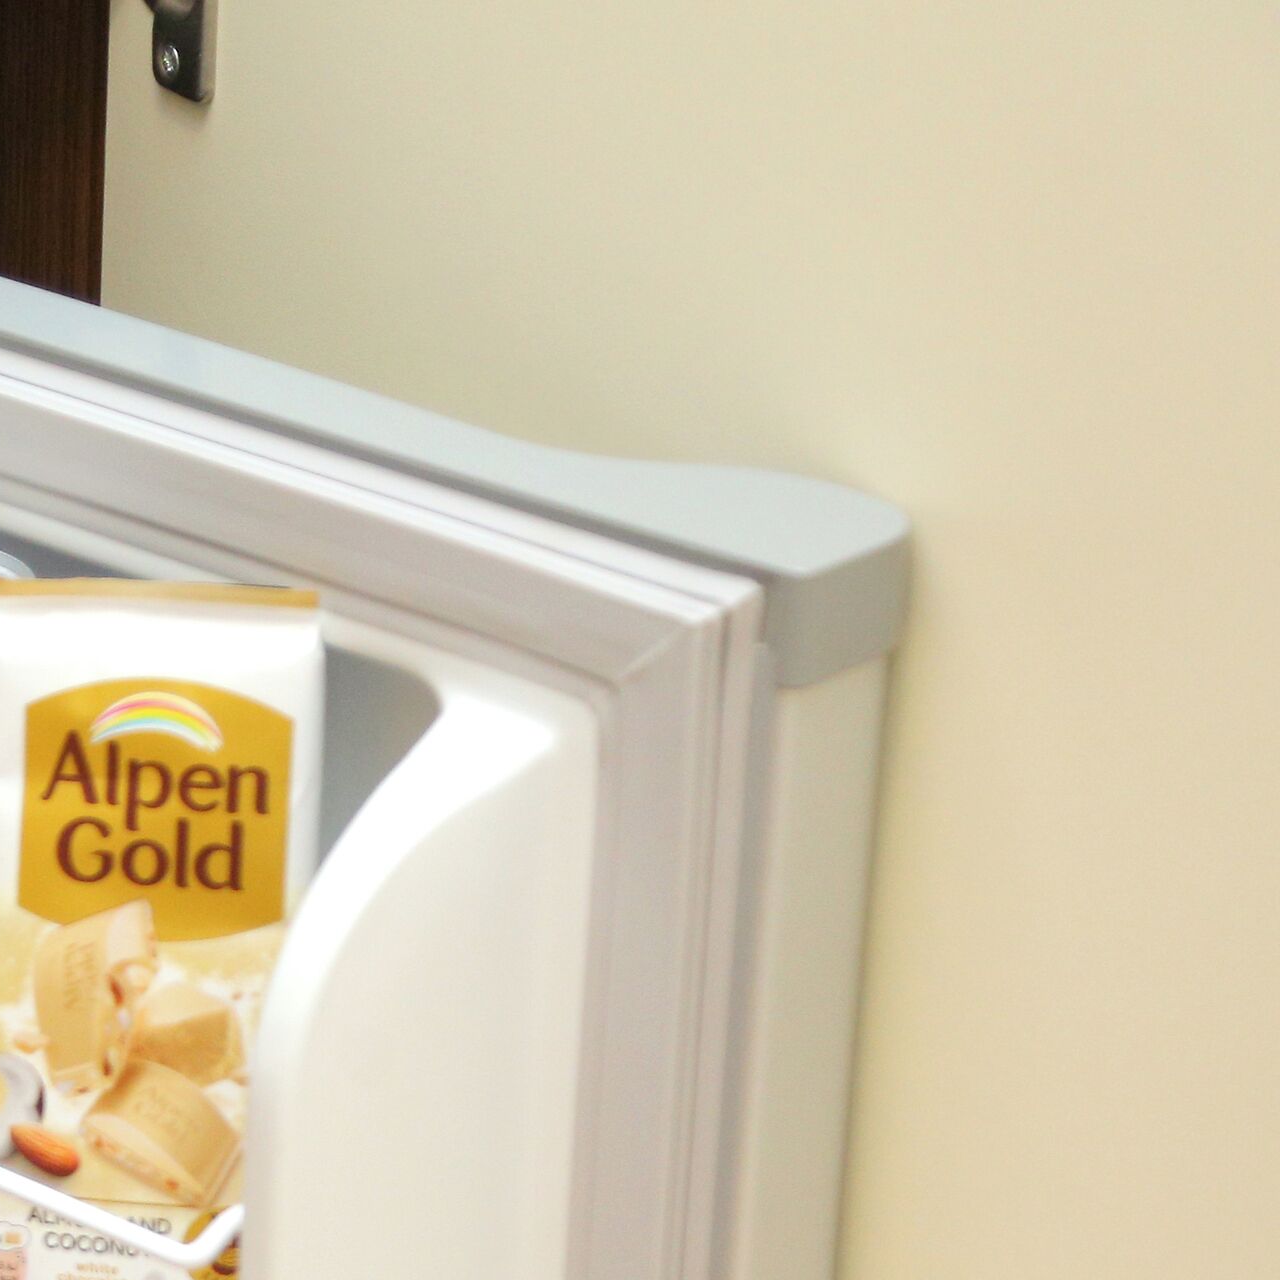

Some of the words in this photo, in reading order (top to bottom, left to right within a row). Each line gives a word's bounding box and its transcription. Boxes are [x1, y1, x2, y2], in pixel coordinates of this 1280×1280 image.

[41, 729, 270, 832] Alpen
[55, 816, 244, 891] Gold
[44, 1231, 144, 1257] COCONU
